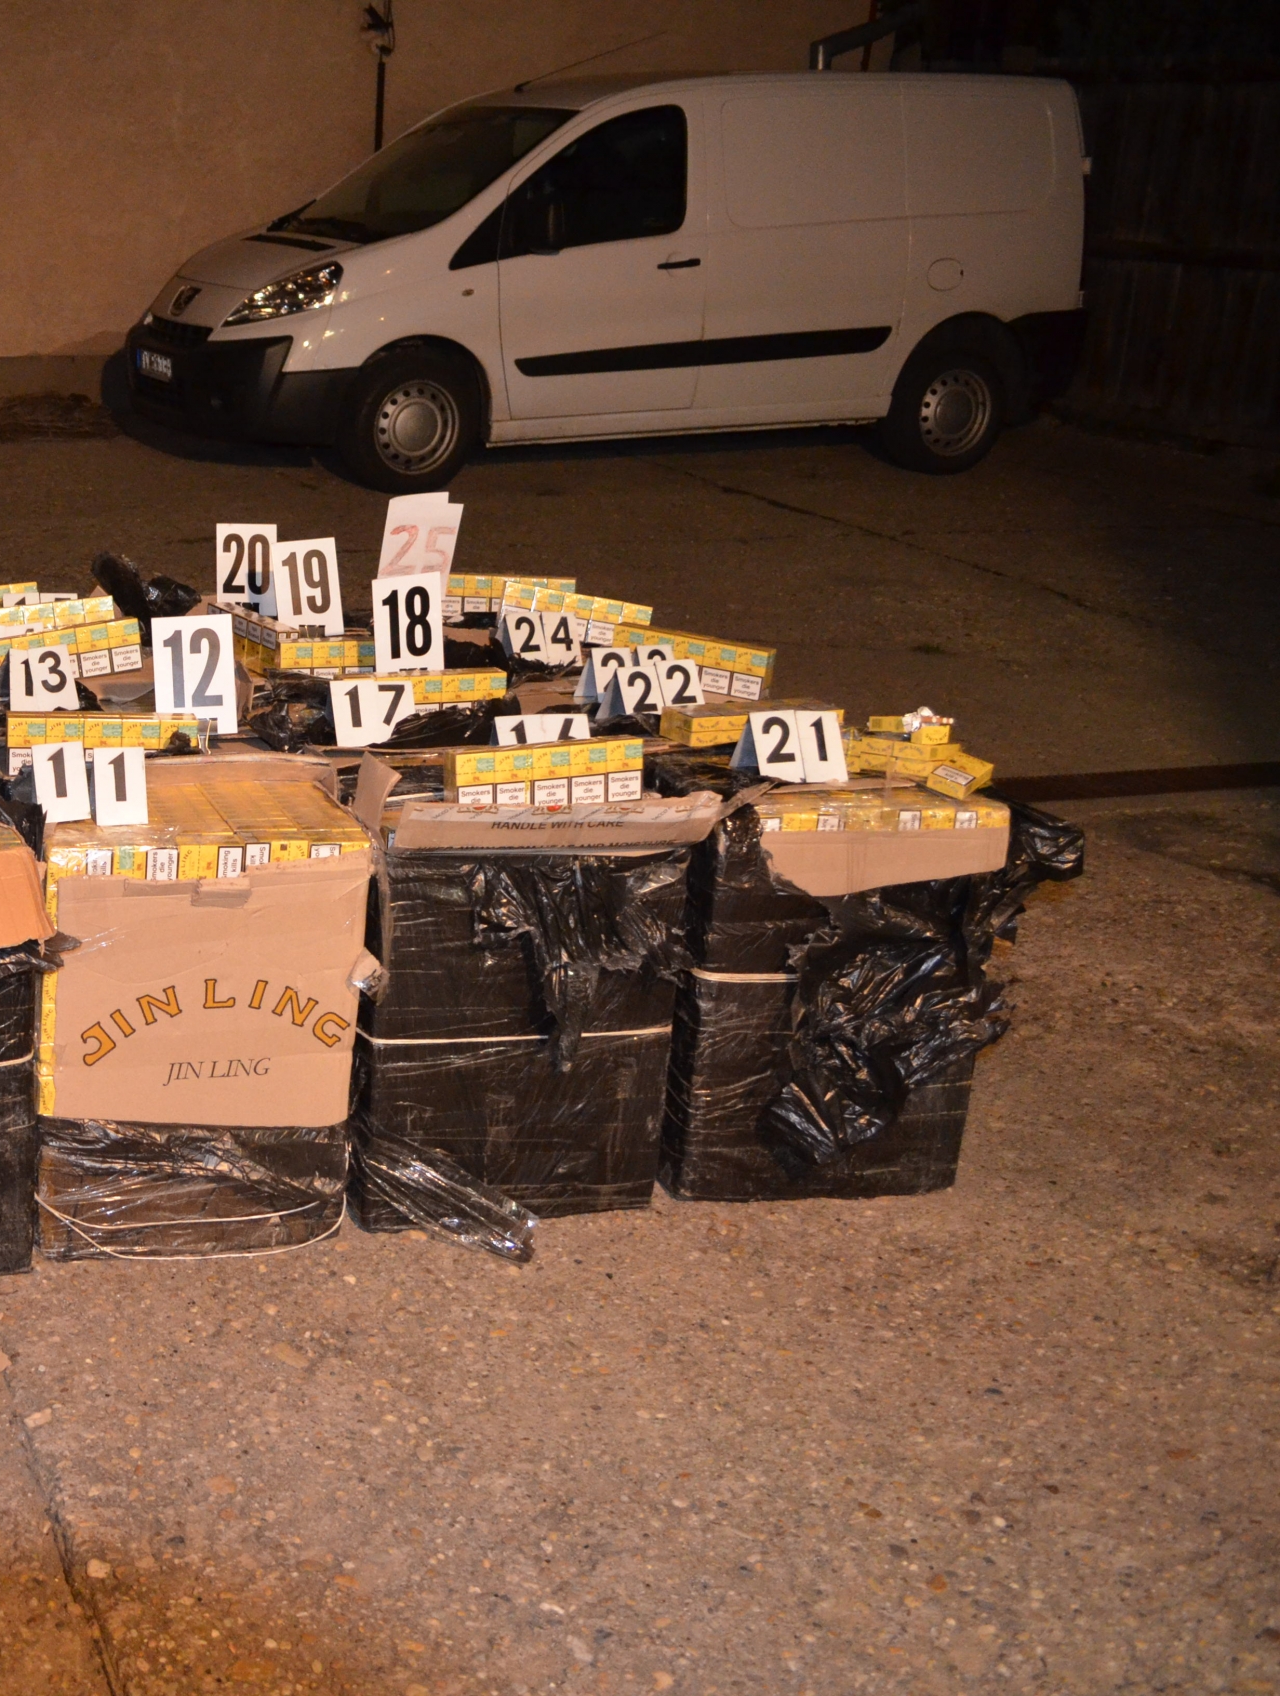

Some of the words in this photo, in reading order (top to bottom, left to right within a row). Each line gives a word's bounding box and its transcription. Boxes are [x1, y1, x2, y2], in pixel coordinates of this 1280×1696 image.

[223, 533, 270, 595] 20
[378, 525, 456, 575] 25
[282, 549, 331, 616] 19
[382, 586, 432, 659] 18
[515, 616, 573, 652] 24
[82, 654, 108, 662] Smokers
[114, 648, 139, 656] Smokers
[116, 660, 139, 668] younger
[163, 628, 223, 708] 12
[20, 651, 67, 697] 13
[628, 664, 697, 713] 22
[344, 684, 405, 728] 17
[762, 716, 828, 763] 21
[537, 783, 565, 791] Smokers
[574, 779, 602, 788] Smokers
[575, 793, 601, 802] younger
[608, 789, 638, 798] younger
[611, 775, 639, 784] Smokers
[491, 821, 547, 830] HANDLE
[81, 985, 182, 1066] JIN
[203, 978, 350, 1048] LING
[163, 1061, 203, 1086] JIN
[209, 1058, 271, 1078] LING
